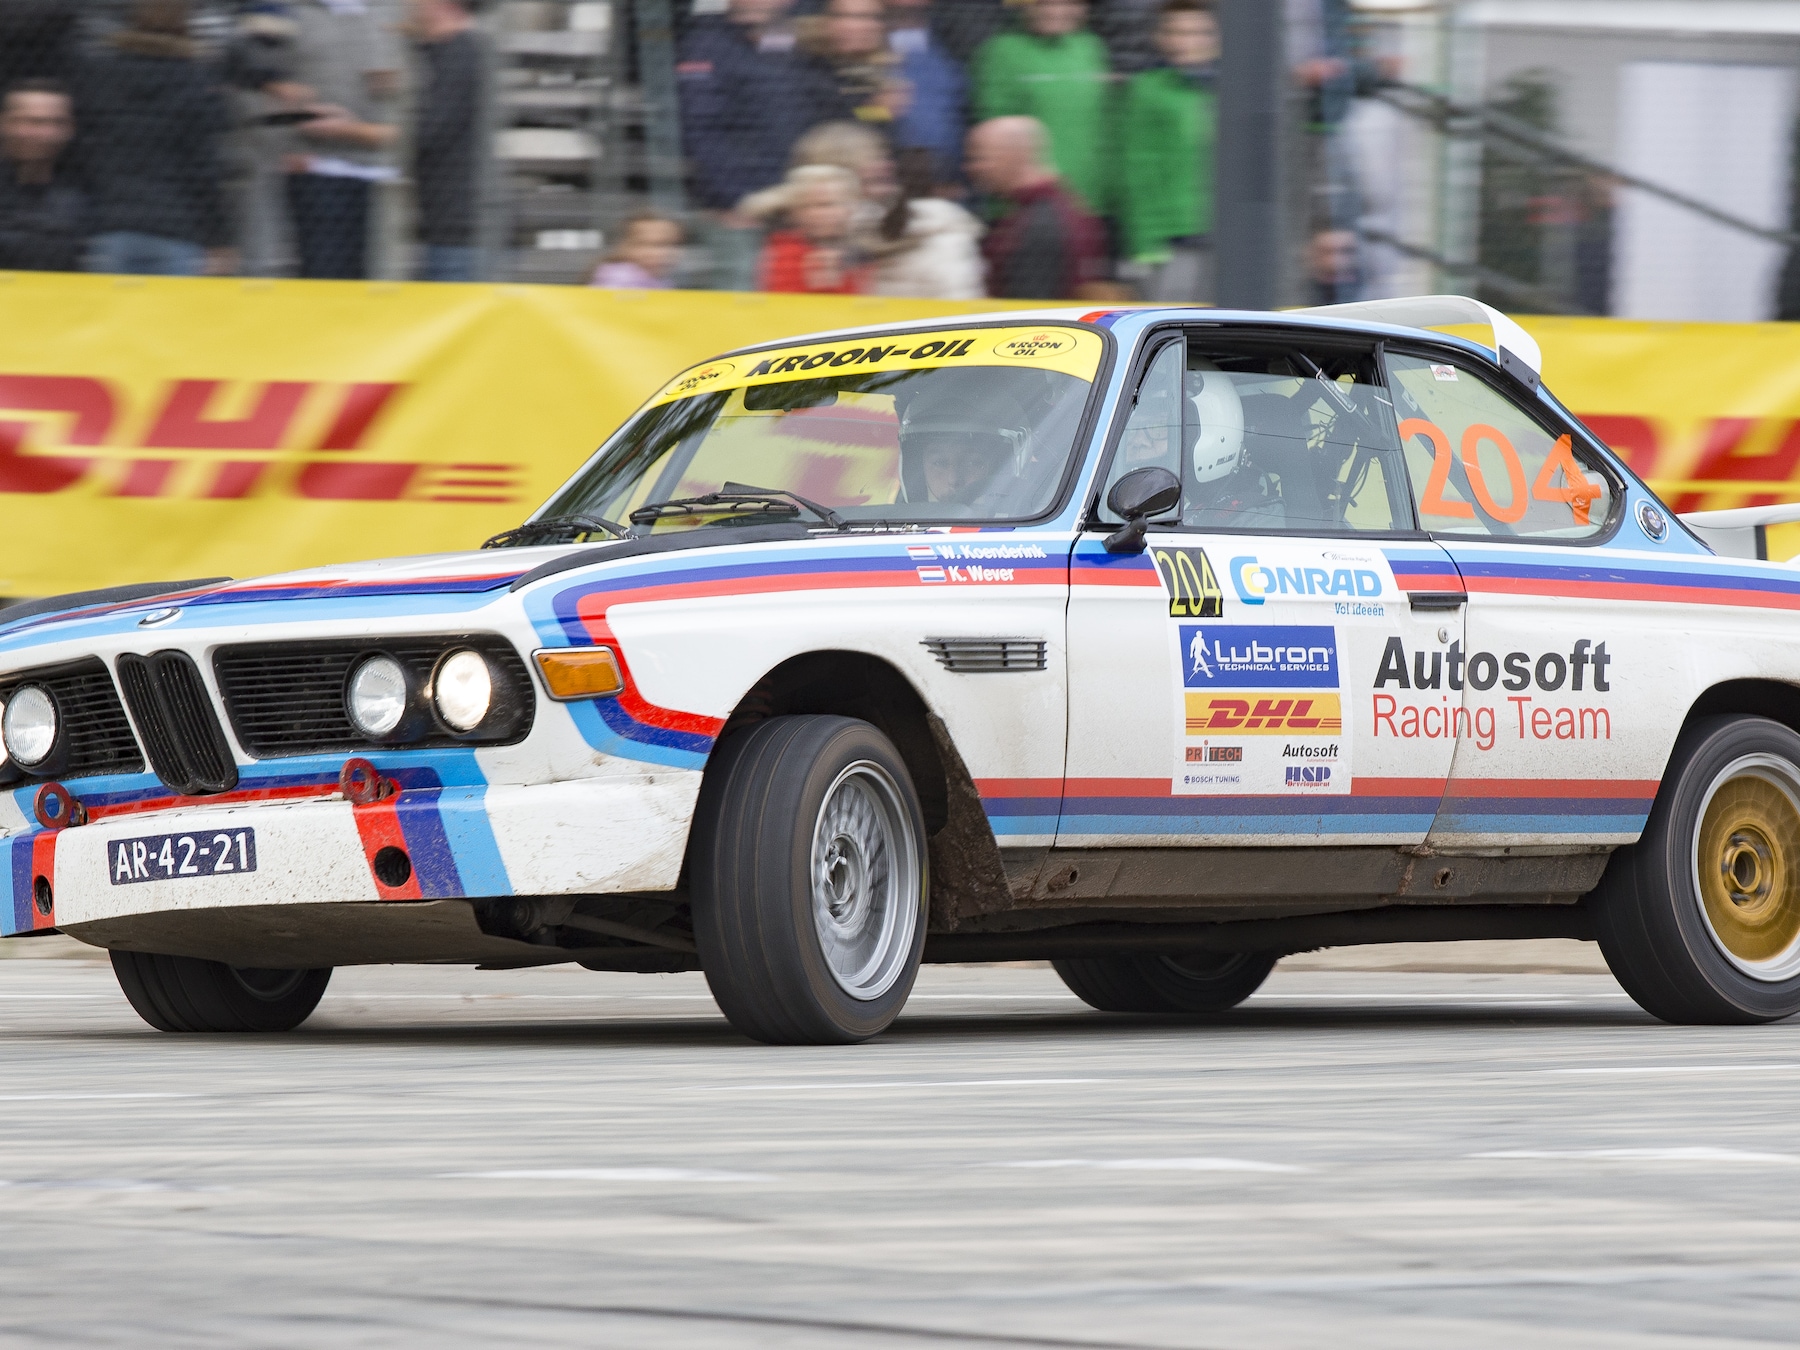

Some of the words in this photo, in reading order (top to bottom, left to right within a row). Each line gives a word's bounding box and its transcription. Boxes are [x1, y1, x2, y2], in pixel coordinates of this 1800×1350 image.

[745, 338, 977, 377] KROON-OIL
[1006, 341, 1063, 349] KROON
[0, 374, 425, 503] DHL
[1398, 418, 1602, 525] 204
[936, 545, 961, 559] W.
[959, 544, 1047, 559] Koenderink
[948, 566, 967, 582] K.
[966, 565, 1014, 581] Wever
[1156, 550, 1222, 616] 204
[1229, 556, 1382, 605] CONRAD
[1335, 602, 1350, 615] Vol
[1352, 602, 1385, 617] ideeën
[1218, 663, 1276, 671] TECHNICAL
[1280, 664, 1330, 672] SERVICES
[1373, 636, 1611, 692] Autosoft
[1207, 700, 1322, 728] DHL
[1372, 694, 1496, 751] Racing
[1507, 696, 1611, 740] Team
[1282, 744, 1339, 758] Autosoft
[1191, 776, 1213, 784] BOSCH
[1215, 776, 1240, 784] TUNING
[1286, 767, 1331, 783] HSP
[116, 832, 248, 881] AR-42-21
